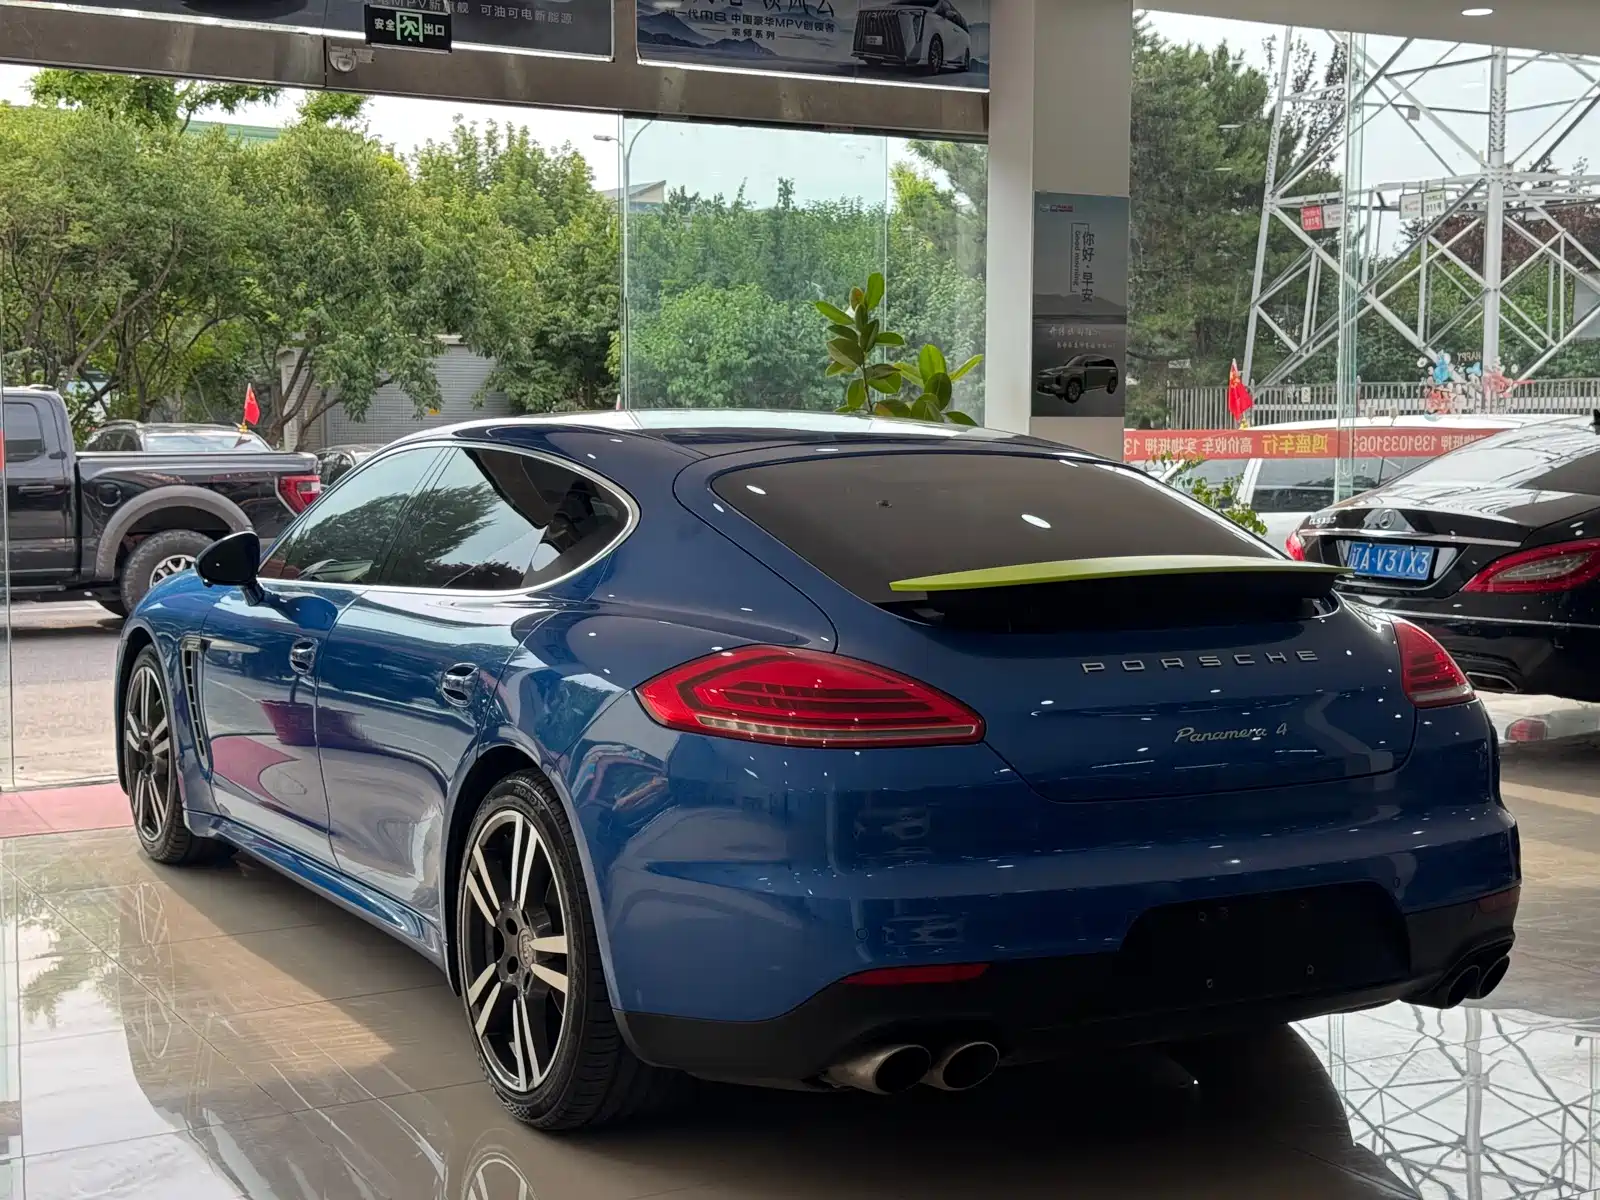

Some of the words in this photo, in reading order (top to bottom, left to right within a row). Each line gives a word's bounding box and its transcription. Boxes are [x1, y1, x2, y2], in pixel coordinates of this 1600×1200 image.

[480, 4, 574, 25] 可油可电新能源
[374, 17, 395, 32] 安全
[424, 23, 445, 37] 出口
[730, 27, 776, 41] 宗师系列
[1080, 650, 1319, 674] PORSCHE
[1174, 726, 1268, 743] Panamera
[1275, 722, 1289, 736] 4
